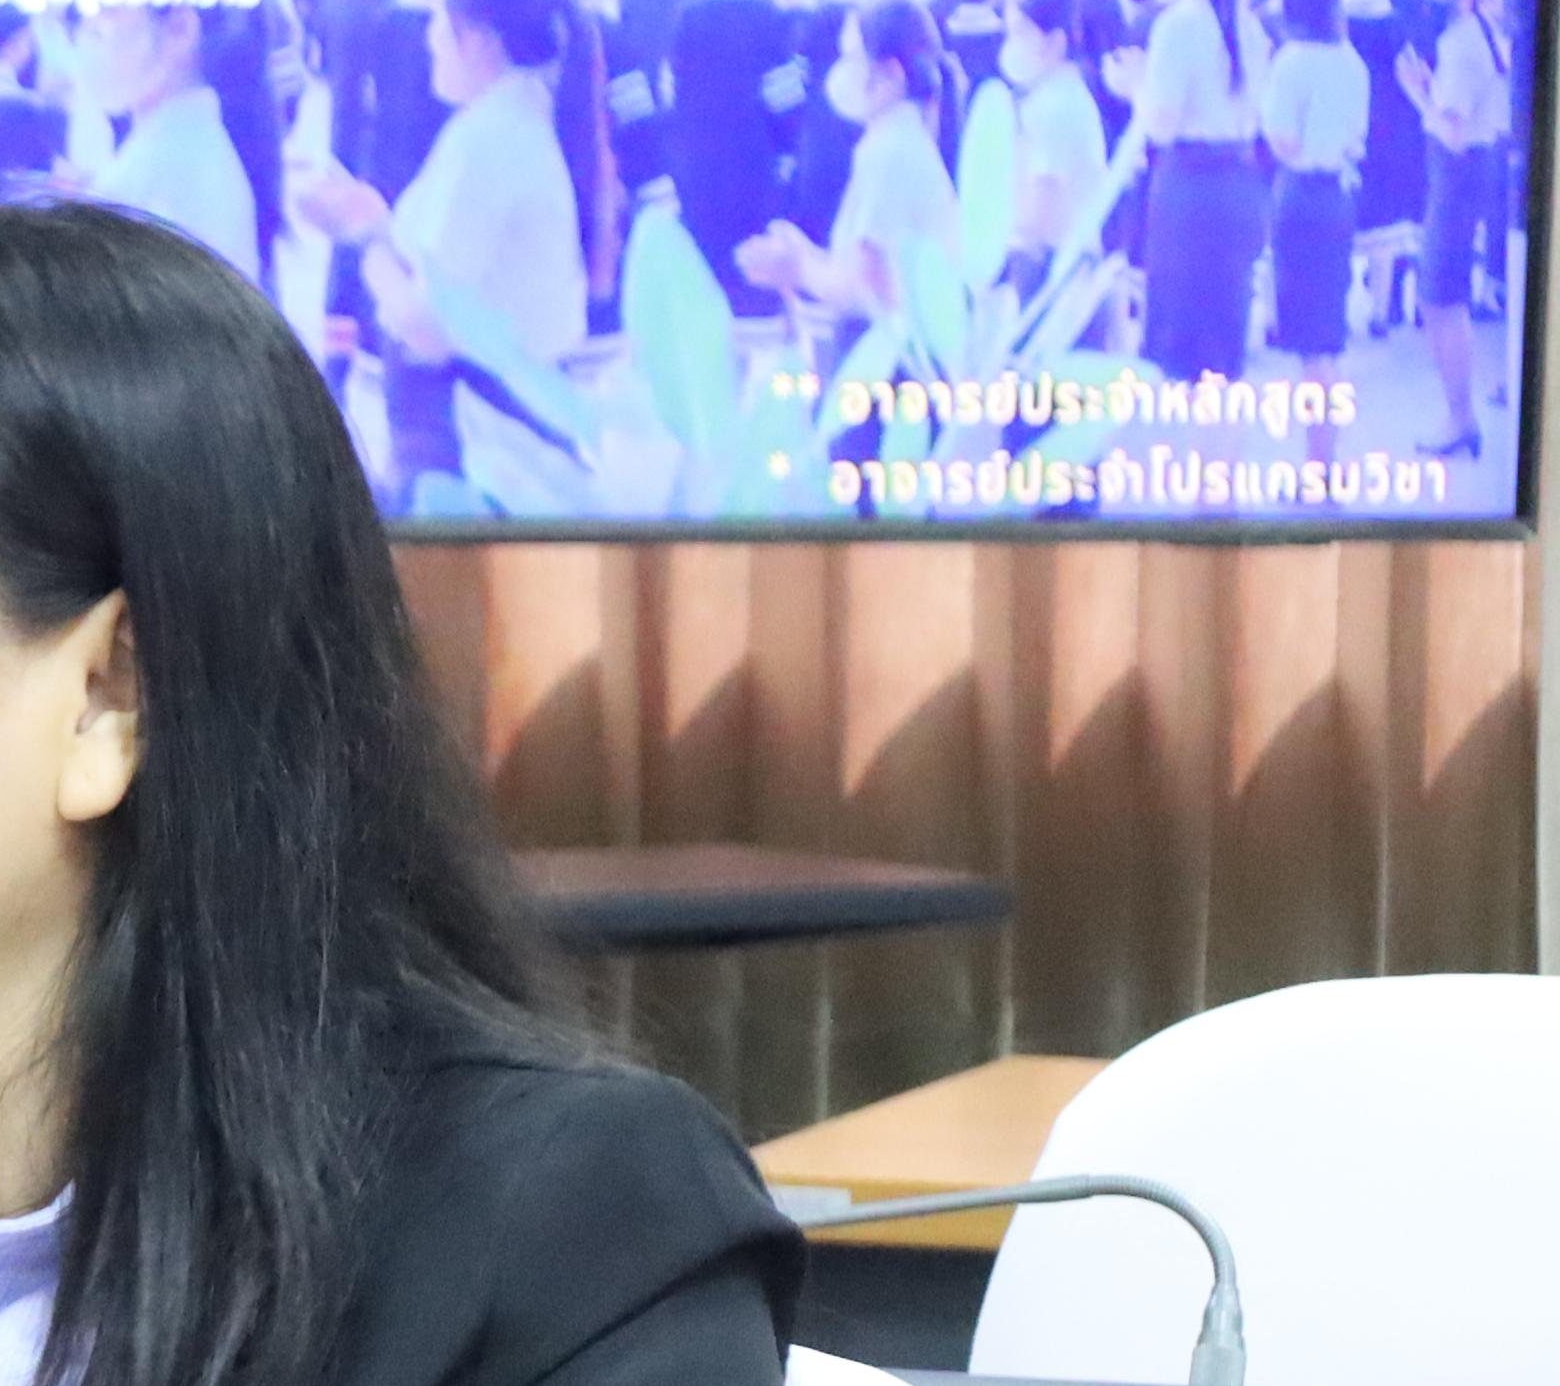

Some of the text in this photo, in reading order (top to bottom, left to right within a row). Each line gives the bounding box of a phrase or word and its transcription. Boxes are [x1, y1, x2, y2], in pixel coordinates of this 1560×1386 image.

[834, 367, 1360, 441] อาจารย์ประจำหลักสูตร
[826, 441, 1452, 507] อาจารย์ประจำโปรแกรมวิชา
